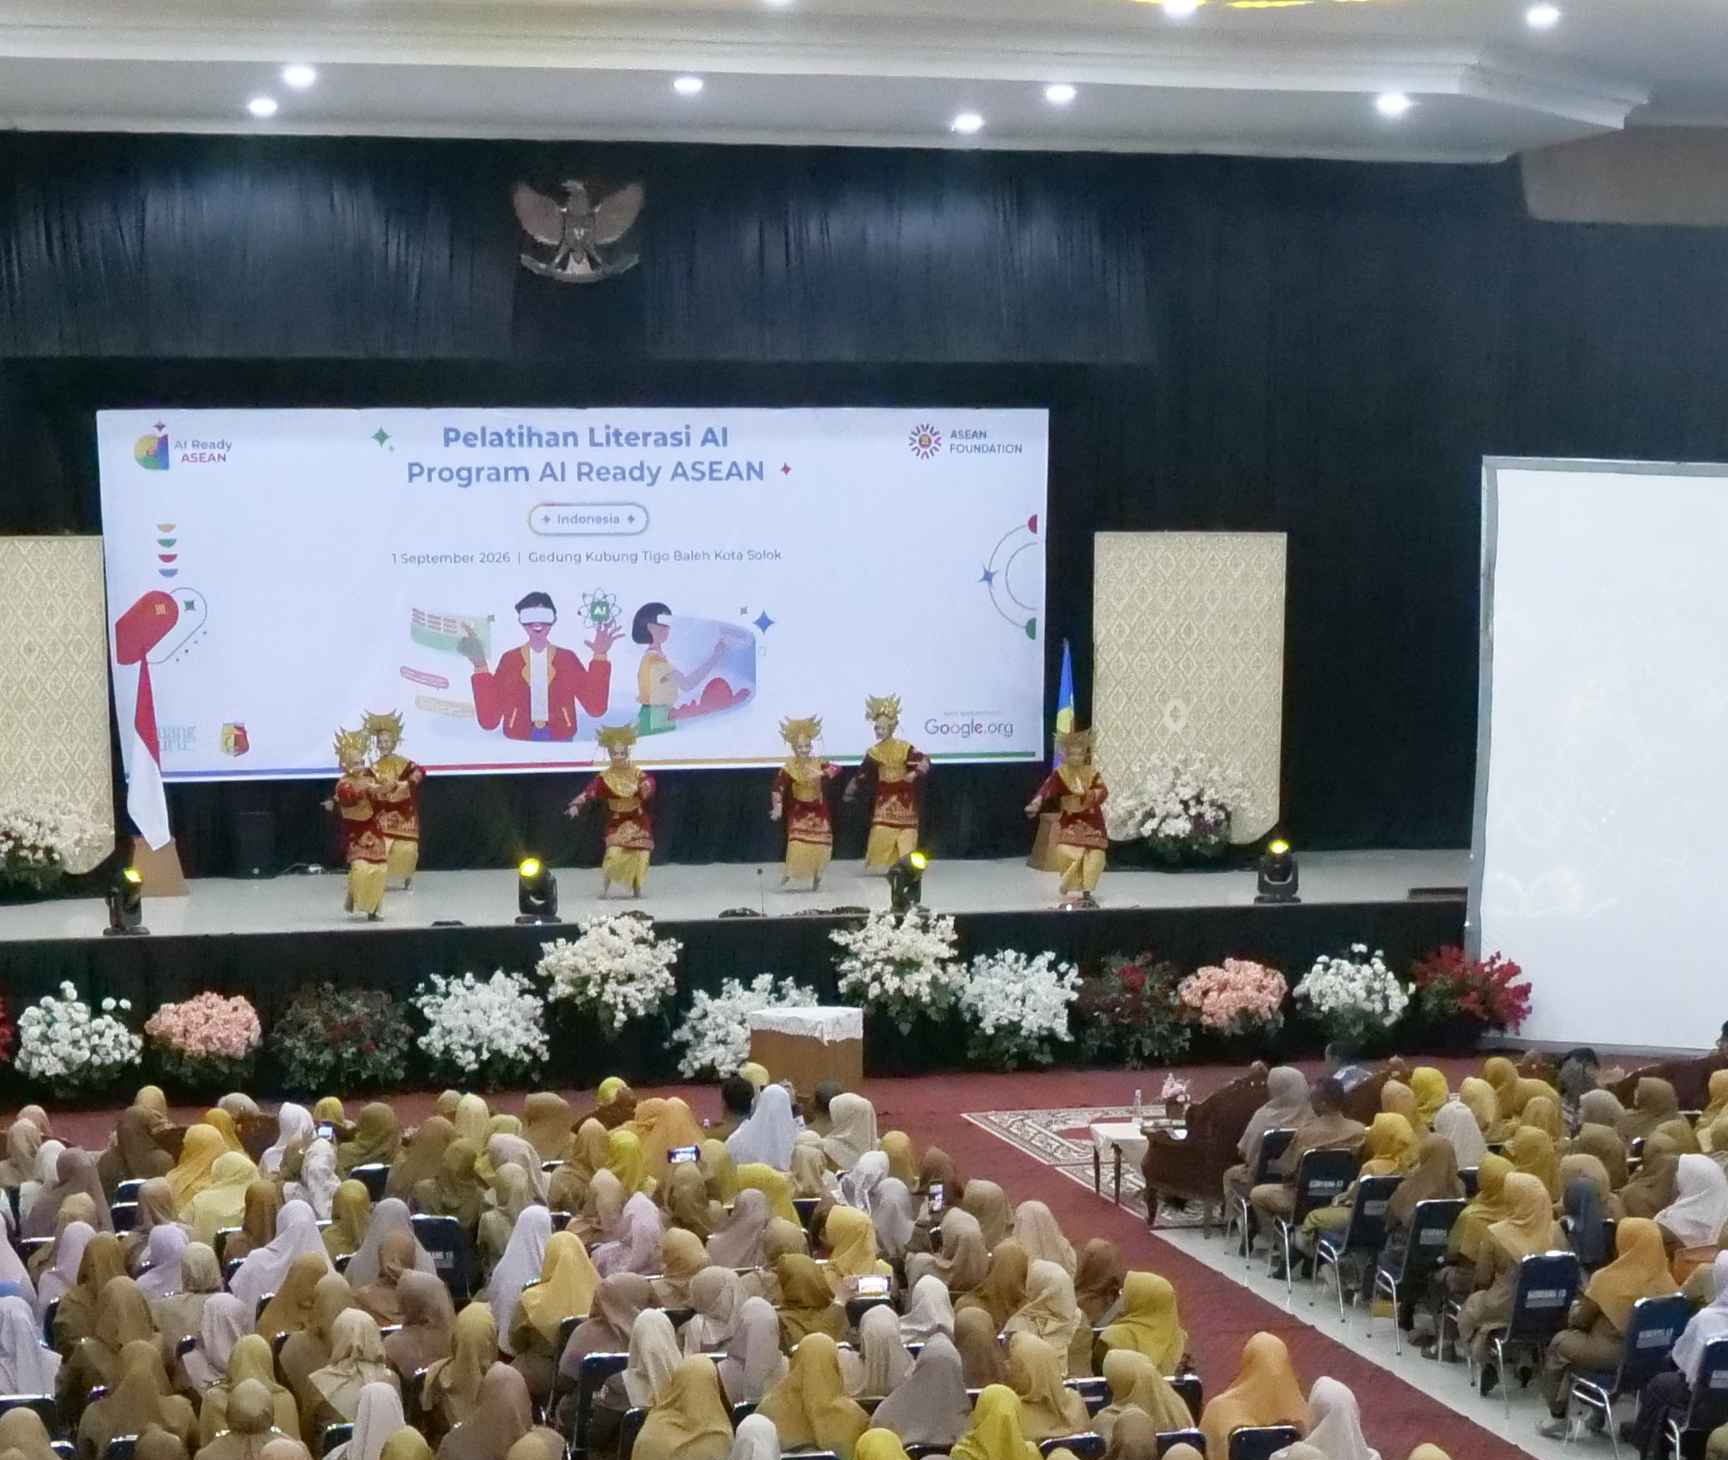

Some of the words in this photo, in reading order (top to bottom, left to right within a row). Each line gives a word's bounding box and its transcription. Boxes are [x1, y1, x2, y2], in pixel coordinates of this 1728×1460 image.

[442, 425, 579, 449] Pelatihan
[588, 424, 691, 448] Literasi
[700, 425, 729, 448] AI
[950, 429, 987, 440] ASEAN
[174, 440, 188, 450] AI
[192, 439, 232, 452] Ready
[949, 443, 1023, 454] FOUNDATION
[180, 452, 227, 463] ASEAN
[407, 461, 530, 488] Program
[538, 461, 566, 483] AI
[576, 460, 661, 487] Ready
[671, 459, 765, 483] ASEAN
[556, 511, 621, 526] Indonesia
[400, 552, 474, 567] September
[528, 551, 583, 566] Gedung
[747, 548, 782, 562] Solok
[594, 606, 607, 615] AI
[923, 718, 1014, 739] Google.org
